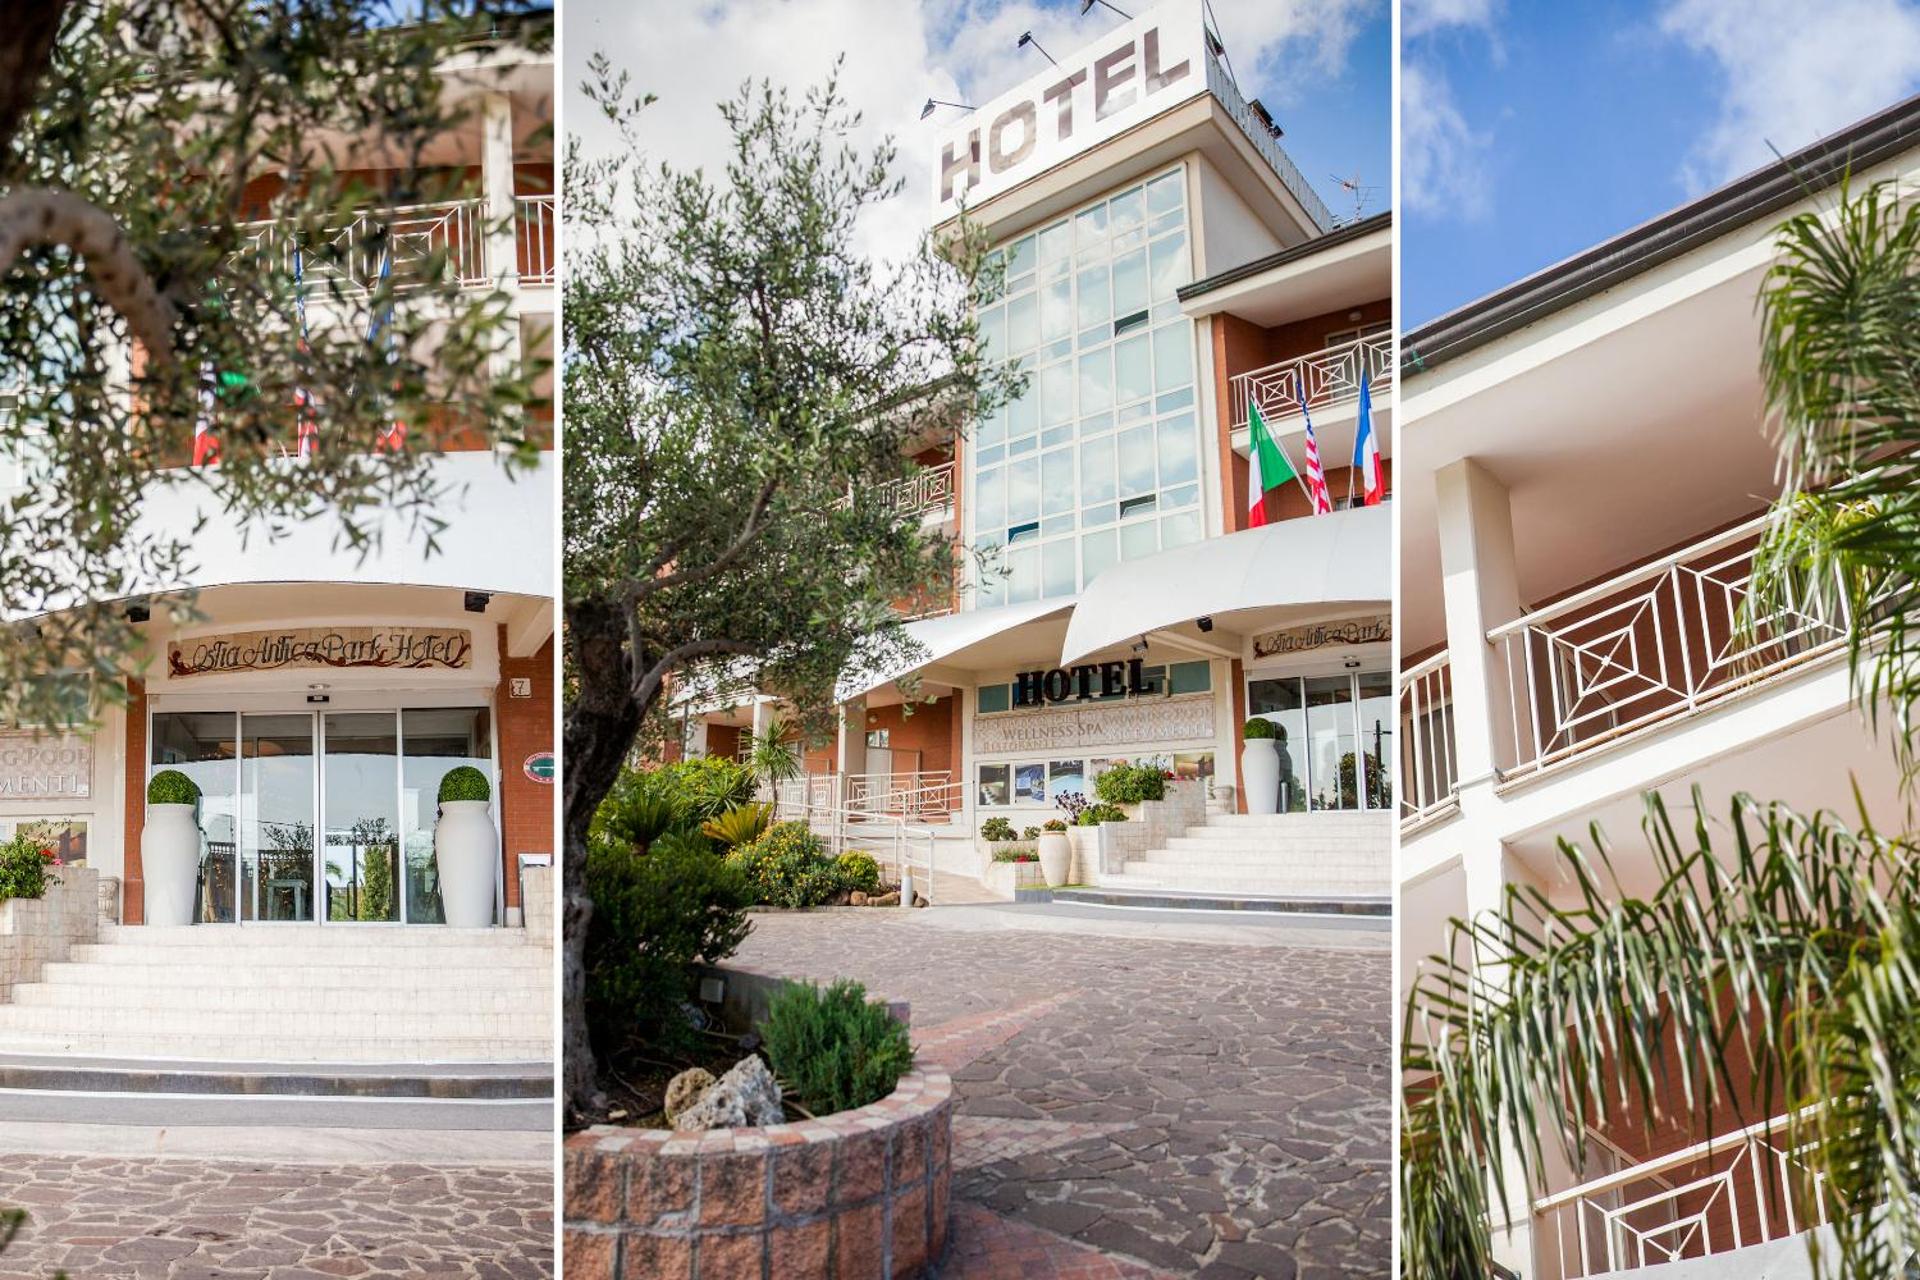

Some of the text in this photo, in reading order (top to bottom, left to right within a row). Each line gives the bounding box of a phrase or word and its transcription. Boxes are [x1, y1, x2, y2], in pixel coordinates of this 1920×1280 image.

[941, 27, 1190, 203] HOTEL
[1343, 619, 1384, 642] Park
[322, 633, 384, 660] Park
[515, 680, 525, 694] 7
[1014, 658, 1154, 706] HOTEL
[1002, 723, 1103, 740] WELLNESS SPA
